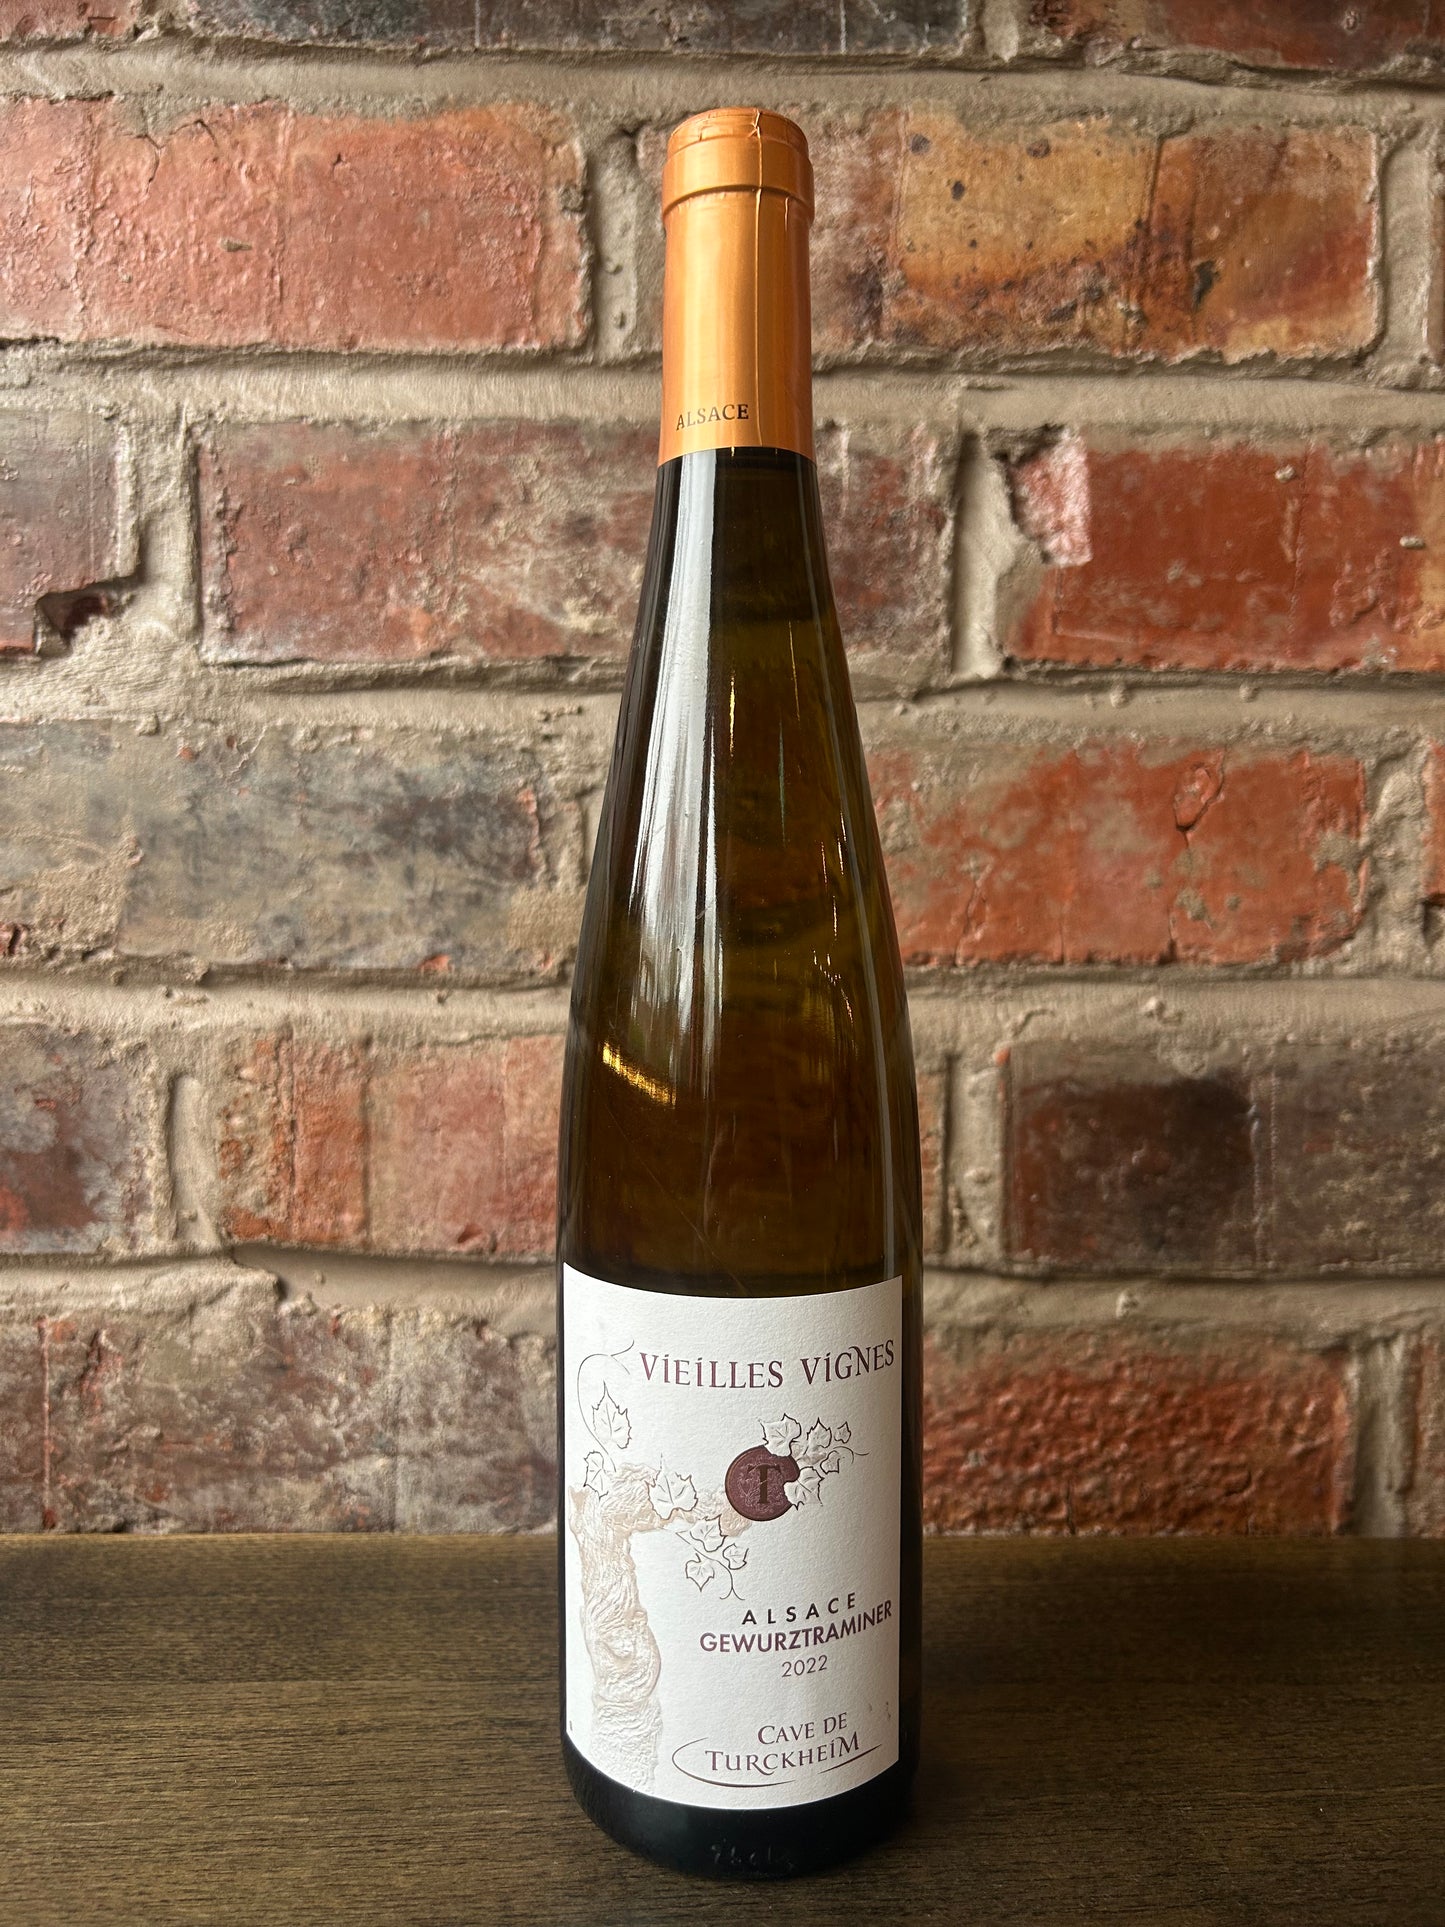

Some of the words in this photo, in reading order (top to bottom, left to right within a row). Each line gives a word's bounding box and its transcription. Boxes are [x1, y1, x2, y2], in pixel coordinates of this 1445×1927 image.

[676, 404, 749, 431] ALSACE
[747, 1463, 781, 1504] T
[742, 1593, 856, 1625] ALSACE
[700, 1601, 892, 1652] GEWURZTRAMINER
[782, 1655, 828, 1678] 2022
[758, 1722, 815, 1744] CAVE
[823, 1712, 848, 1734] DE
